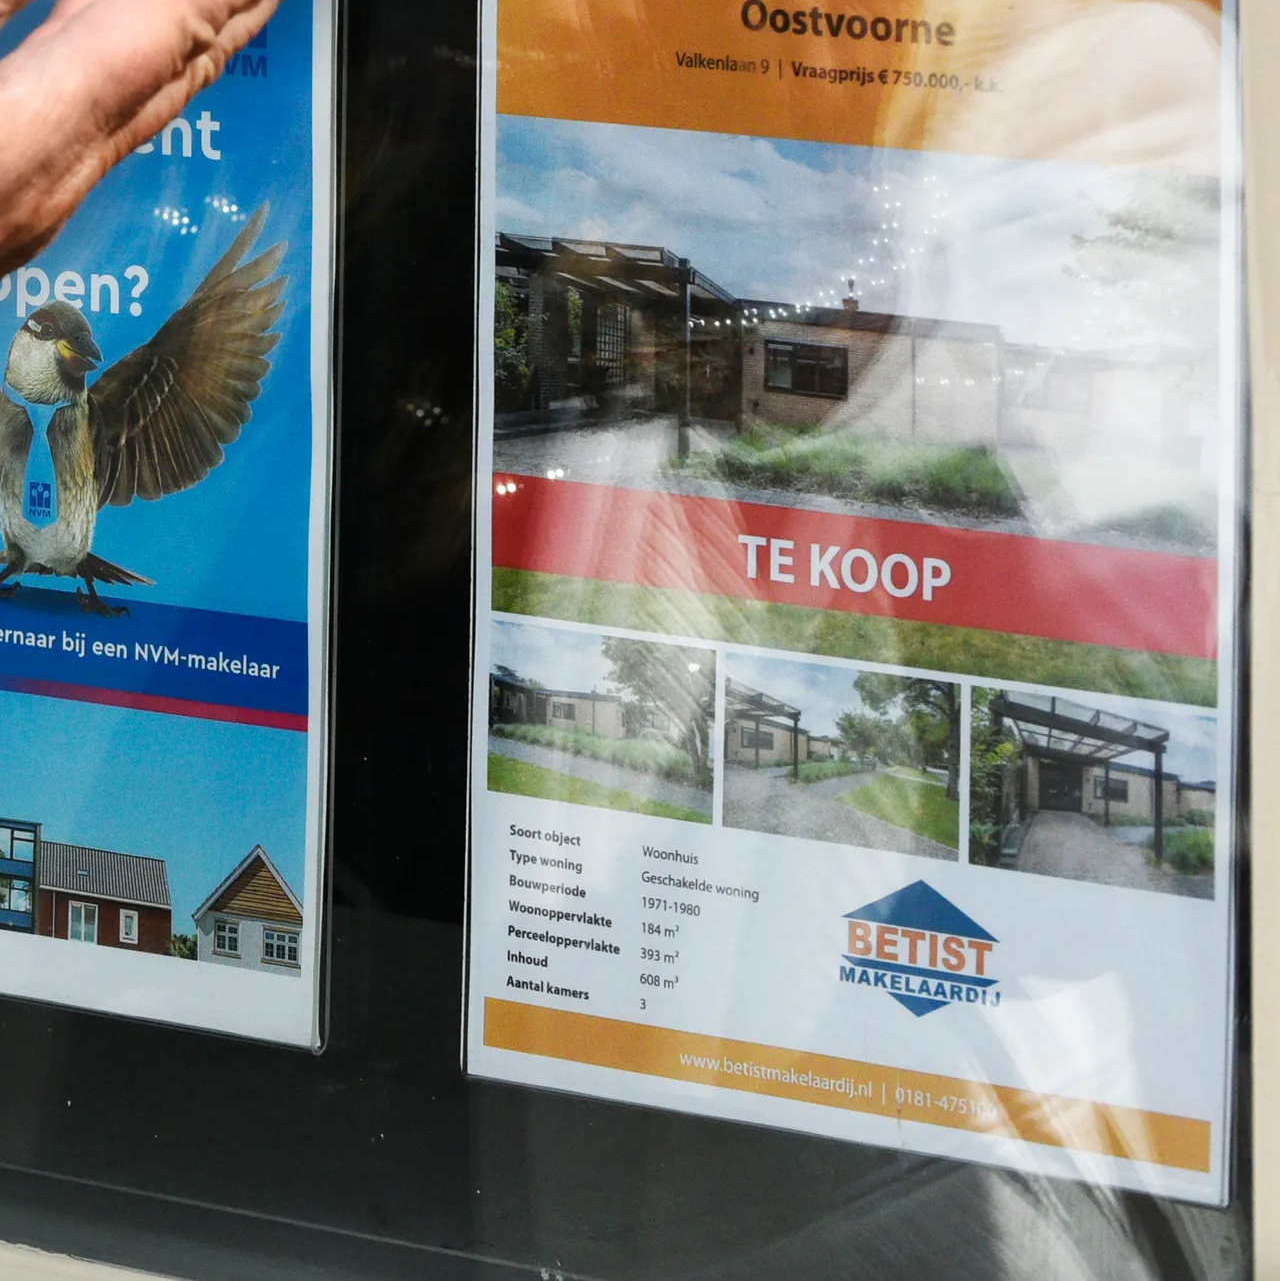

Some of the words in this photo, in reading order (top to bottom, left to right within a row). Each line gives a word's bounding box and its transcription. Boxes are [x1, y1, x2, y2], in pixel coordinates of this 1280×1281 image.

[741, 0, 956, 46] Oostvoorne
[675, 51, 756, 74] Valkenlaan
[760, 58, 770, 73] 9
[792, 62, 874, 85] Vraagprijs
[29, 508, 51, 518] NVM
[738, 534, 795, 584] TE
[810, 543, 952, 601] KOOP
[62, 632, 86, 658] bij
[92, 641, 127, 659] een
[135, 644, 280, 678] NVM-makelaar
[510, 825, 541, 840] Soort
[544, 830, 581, 846] object
[642, 845, 699, 864] Woonhuis
[509, 850, 537, 865] Type
[540, 857, 582, 873] woning
[641, 871, 712, 893] Geschakelde
[716, 885, 759, 902] woning
[509, 875, 586, 898] Bouwperiode
[642, 897, 700, 916] 1971-1980
[509, 900, 612, 928] Woonoppervlakte
[641, 922, 661, 935] 184
[508, 925, 620, 954] Perceeloppervlakte
[640, 948, 660, 961] 393
[848, 920, 993, 976] BETIST
[507, 950, 548, 967] Inhoud
[640, 974, 660, 987] 608
[840, 965, 1001, 1007] MAKELAARDIJ
[507, 976, 543, 992] Aantal
[547, 983, 589, 1000] kamers
[640, 999, 646, 1010] 3
[679, 1050, 872, 1097] www.betistmakelaardij.nl
